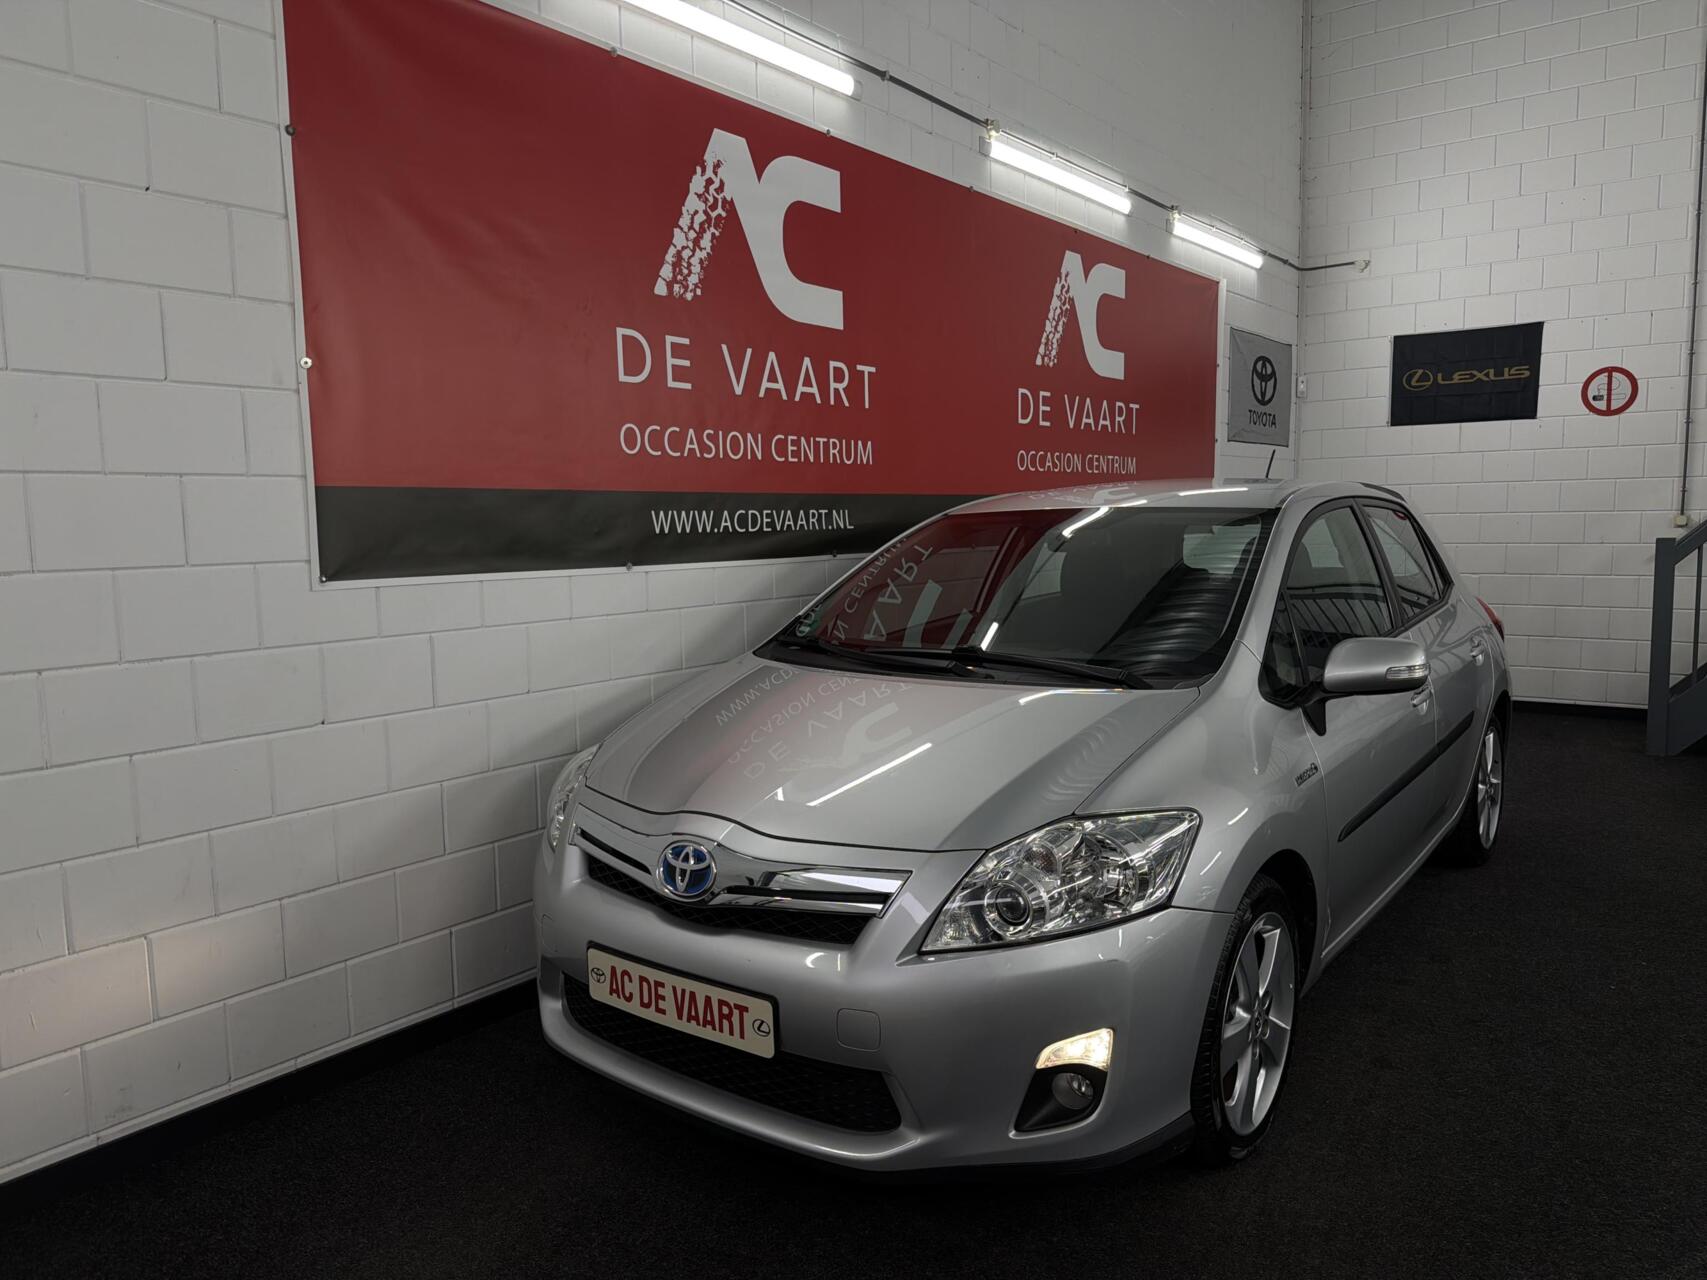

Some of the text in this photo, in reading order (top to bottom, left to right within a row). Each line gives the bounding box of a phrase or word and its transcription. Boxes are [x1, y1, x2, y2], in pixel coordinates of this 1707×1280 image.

[616, 327, 876, 409] DE VAART
[1438, 366, 1530, 384] LEXUS
[1017, 388, 1140, 435] DE VAART
[1248, 409, 1277, 429] TOYOTA
[619, 422, 873, 465] OCCASION CENTRUM
[1017, 450, 1136, 475] OCCASION CENTRUM
[651, 509, 854, 535] WWW.ACDEVAART.NL
[609, 965, 749, 1040] AC DE VAART
